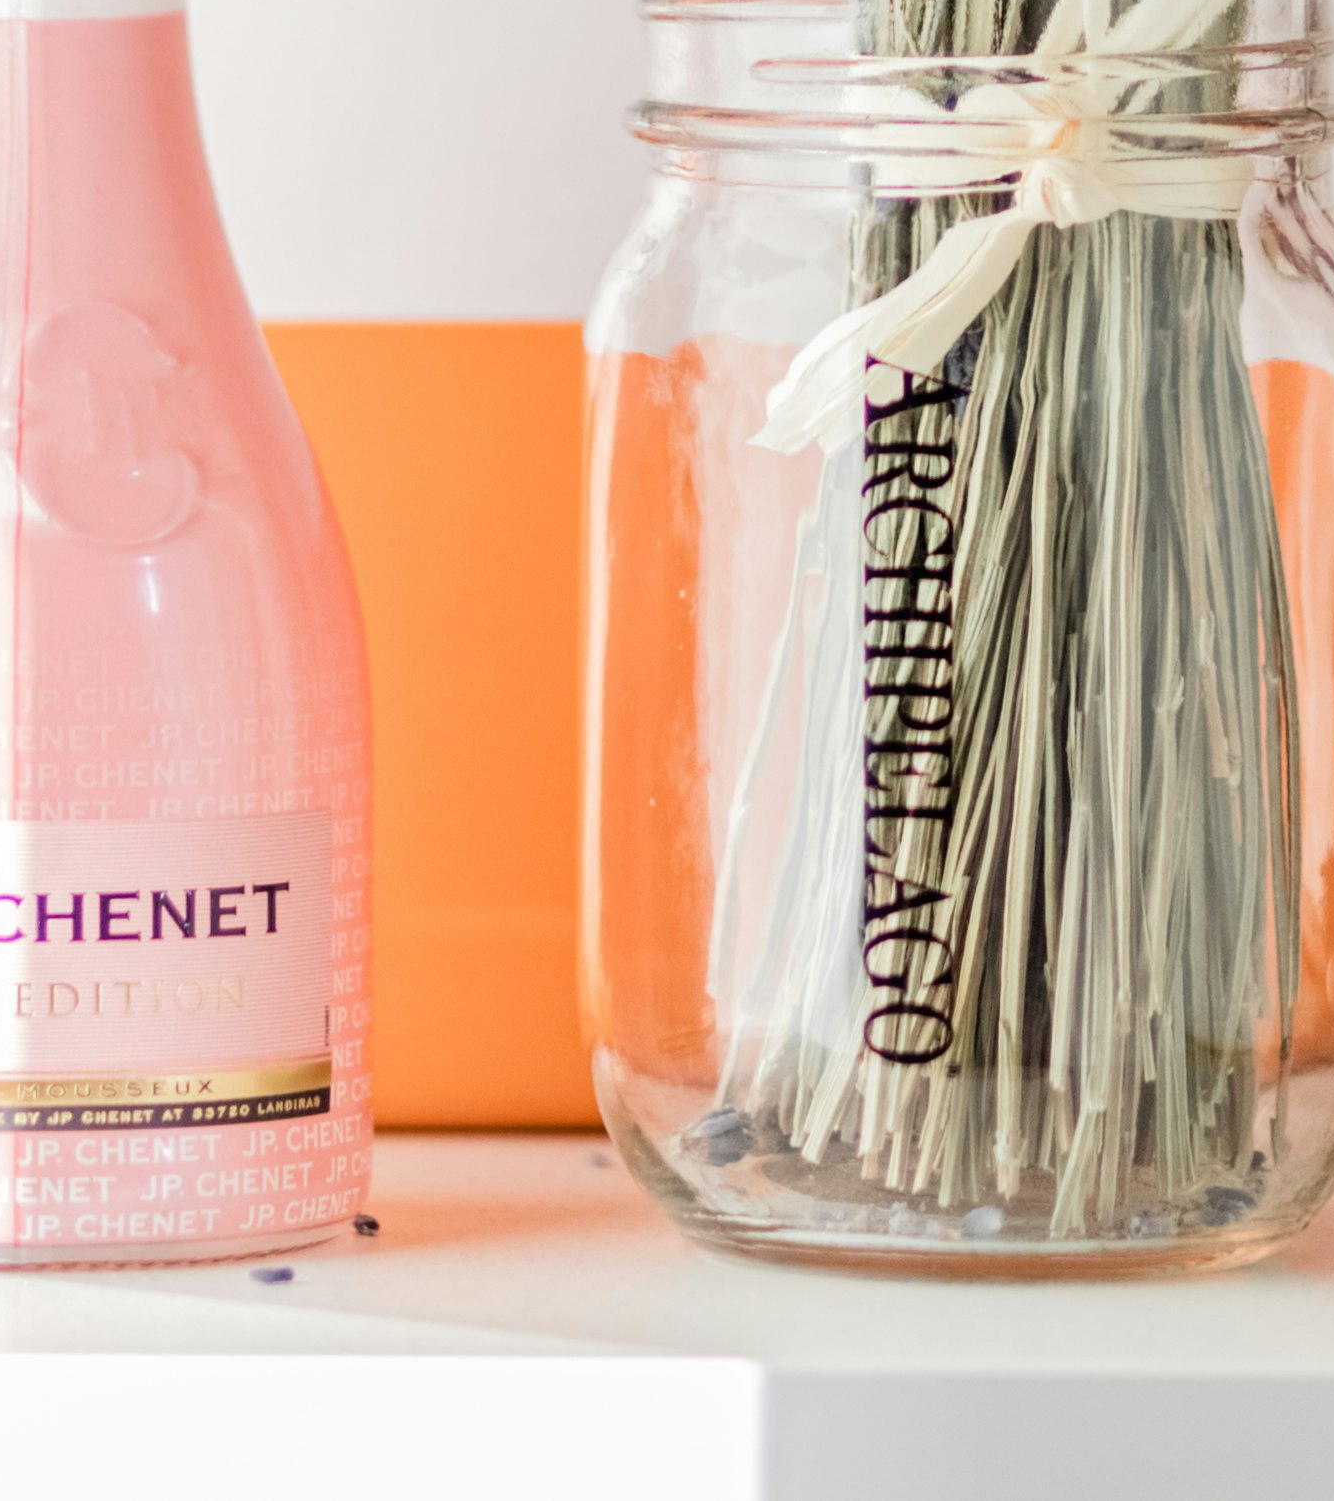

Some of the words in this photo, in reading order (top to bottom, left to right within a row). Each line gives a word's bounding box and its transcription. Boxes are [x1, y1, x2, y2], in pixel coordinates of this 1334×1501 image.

[862, 351, 971, 1065] ARCHIPELAGO
[14, 976, 247, 1018] EDITION
[17, 1077, 214, 1099] MOUSSEUX
[14, 1110, 42, 1127] BY
[47, 1110, 74, 1126] JP
[81, 1108, 154, 1126] CHENET
[161, 1107, 184, 1123] AT
[17, 1138, 63, 1167] JP.
[74, 1134, 219, 1167] CHENET
[242, 1129, 278, 1158] JP.
[285, 1113, 363, 1153] CHENET
[140, 1175, 184, 1201] JP.
[196, 1162, 313, 1197] CHENET
[17, 1213, 63, 1240] JP.
[74, 1208, 221, 1241] CHENET
[239, 1204, 276, 1231] JP.
[283, 1187, 362, 1226] CHENET
